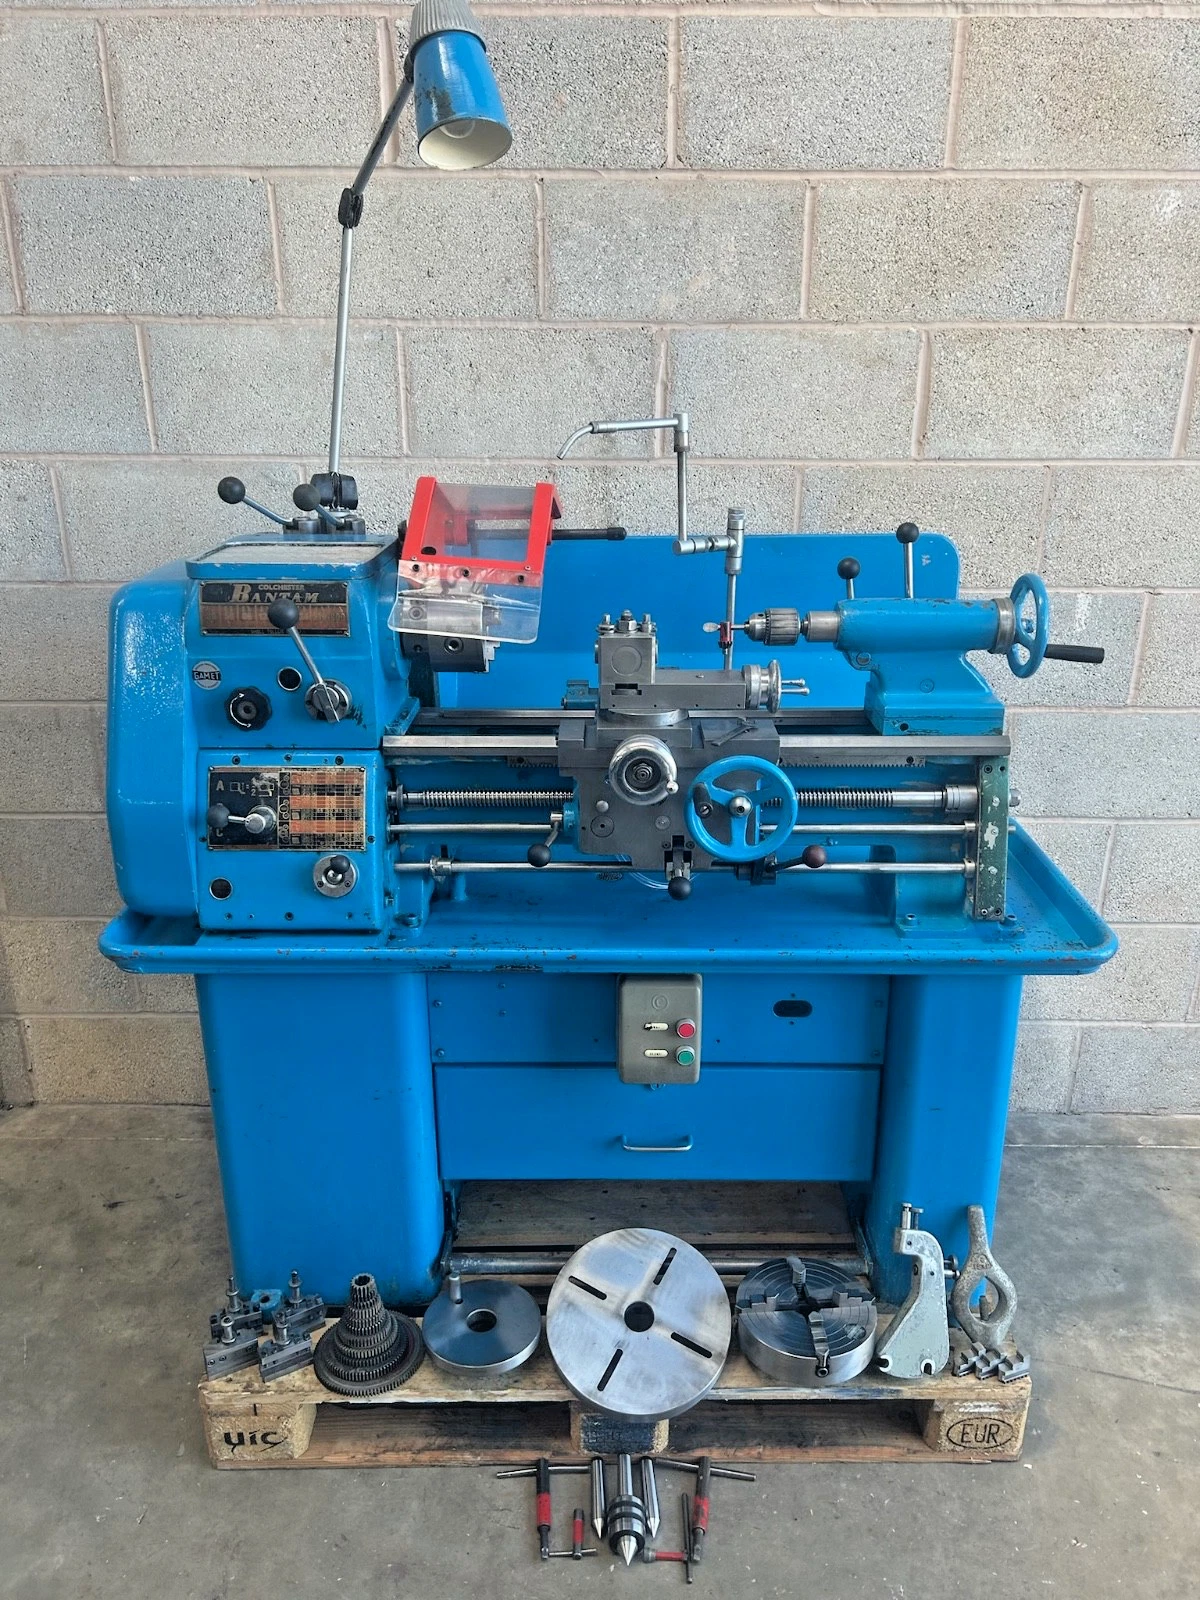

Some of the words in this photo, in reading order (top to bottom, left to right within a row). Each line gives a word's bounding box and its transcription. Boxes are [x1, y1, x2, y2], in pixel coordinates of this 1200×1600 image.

[229, 583, 320, 603] BANTAM
[193, 671, 220, 680] GAMET
[961, 1423, 1000, 1444] EUR
